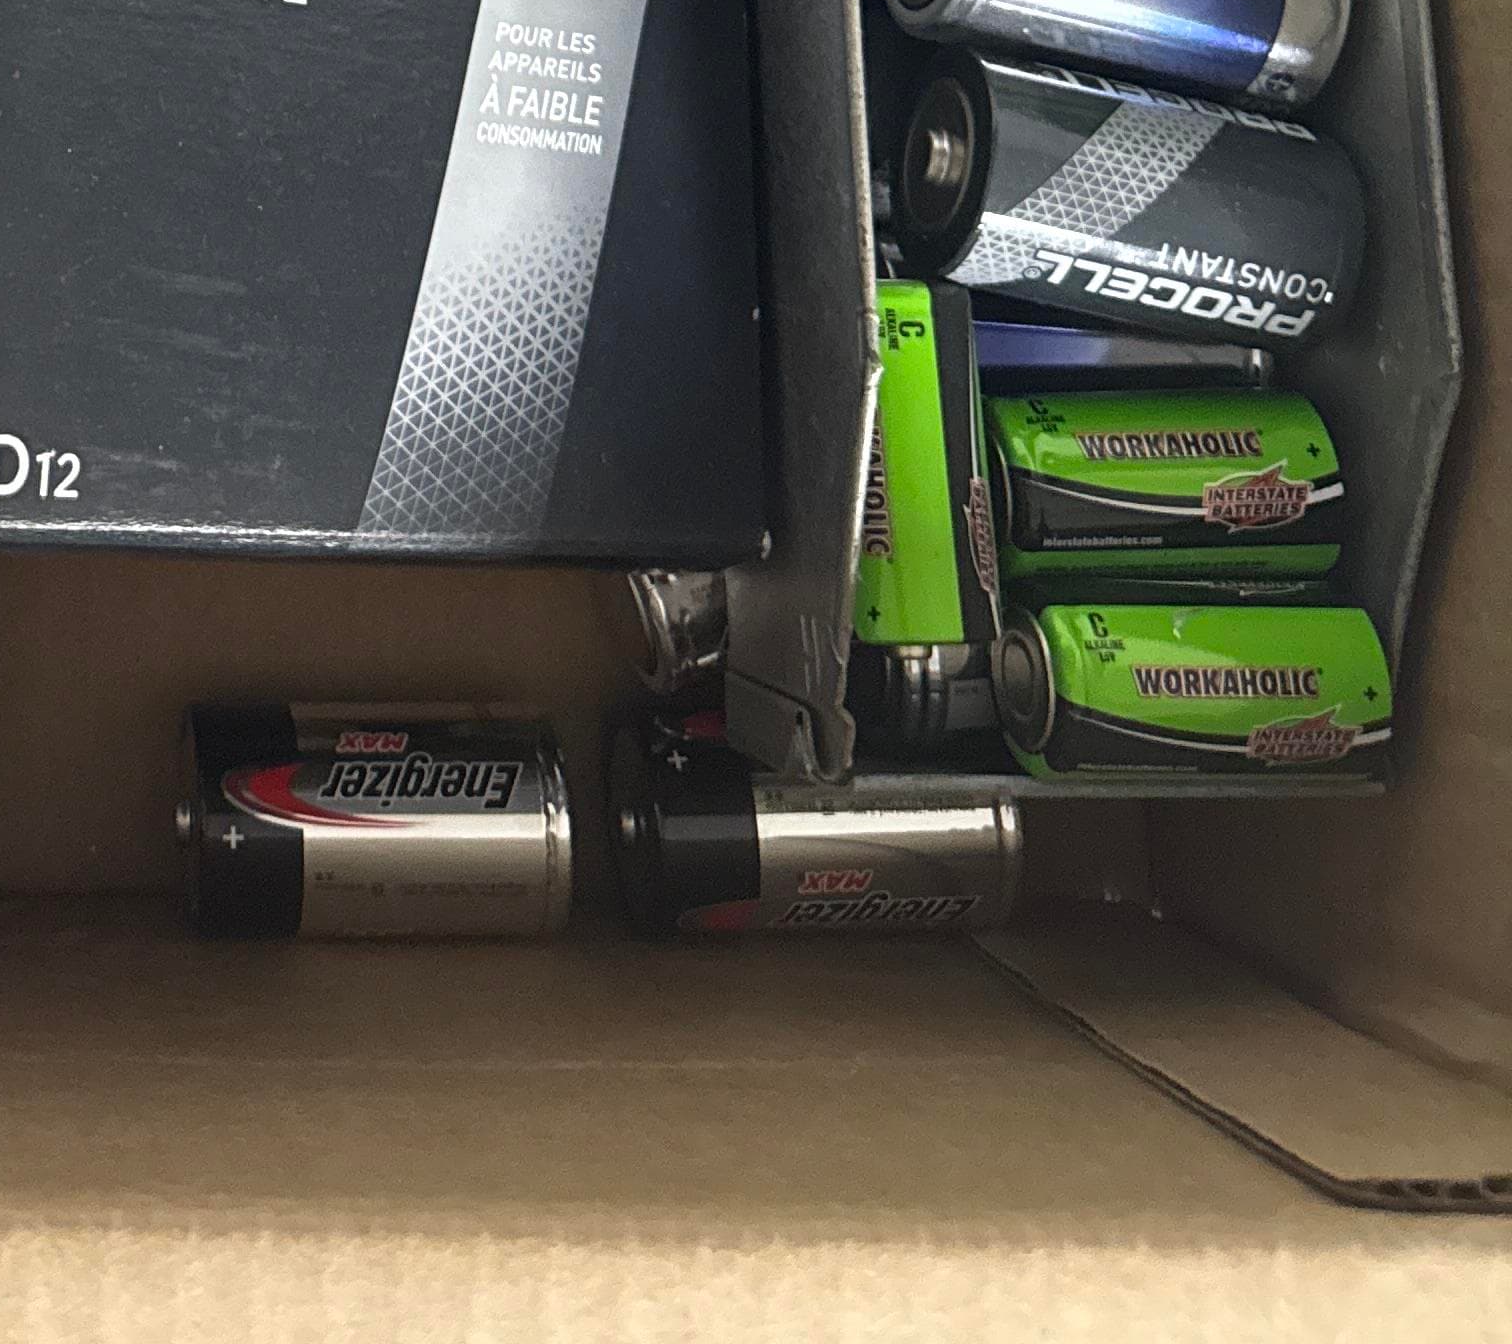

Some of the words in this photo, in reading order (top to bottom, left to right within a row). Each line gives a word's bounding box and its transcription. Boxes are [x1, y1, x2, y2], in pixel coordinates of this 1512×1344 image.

[493, 22, 552, 51] POUR
[555, 30, 596, 55] LES
[487, 51, 603, 85] APPAREILS
[479, 74, 503, 114] À
[506, 85, 605, 127] FAIBLE
[475, 121, 603, 156] CONSOMMATION
[1154, 242, 1334, 305] CONSTANT
[1032, 249, 1315, 338] PROCELL
[885, 307, 901, 351] ALKALINE
[898, 317, 926, 341] C
[1075, 431, 1261, 460] WORKAHOLIC
[1207, 485, 1308, 503] INTERSTATE
[1212, 501, 1301, 518] BATTERIES
[1088, 611, 1109, 639] C
[1134, 666, 1320, 698] WORKAHOLIC
[337, 731, 408, 754] MAX
[1252, 727, 1355, 745] INTERSTATE
[320, 756, 525, 809] Energizer
[798, 869, 872, 893] MAX
[779, 894, 981, 930] Energizer
